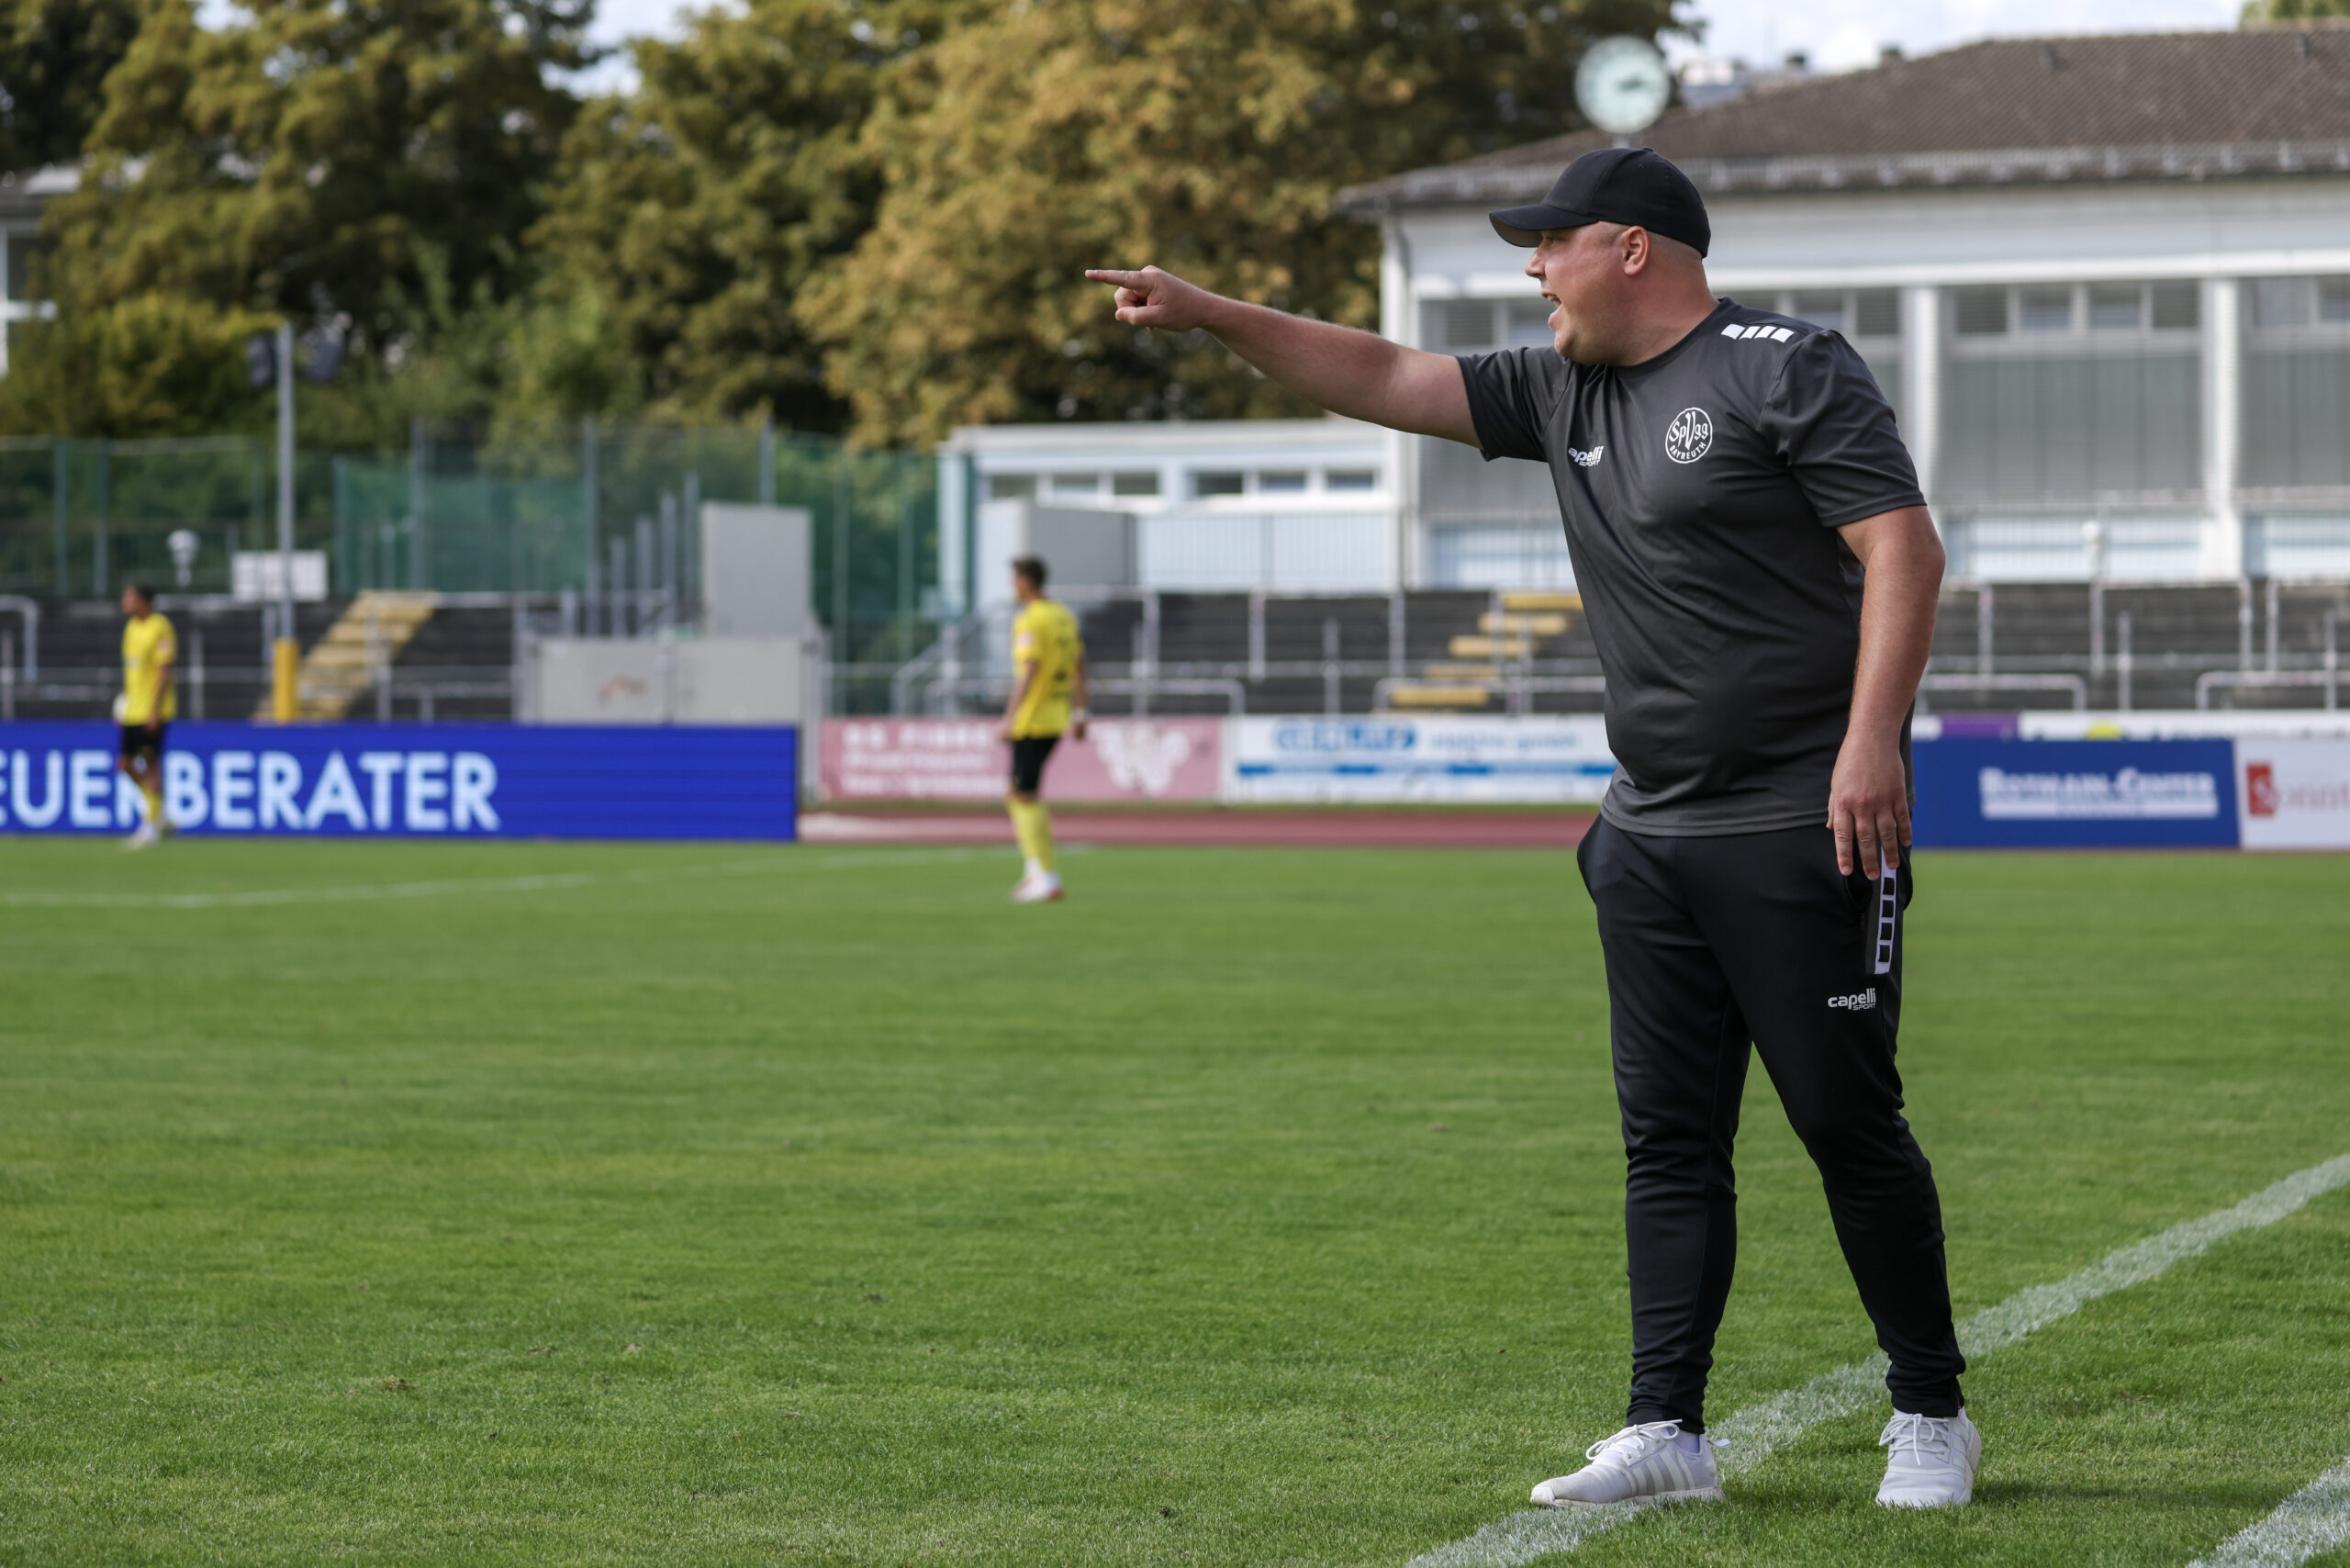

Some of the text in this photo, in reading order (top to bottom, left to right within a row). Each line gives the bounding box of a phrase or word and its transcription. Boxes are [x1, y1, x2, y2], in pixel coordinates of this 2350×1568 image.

[1568, 445, 1605, 463] apelli
[1669, 442, 1707, 460] BAYREUTH
[0, 748, 500, 830] UEBERATER
[1827, 987, 1876, 1010] capelli
[1852, 1002, 1876, 1011] SPORT
